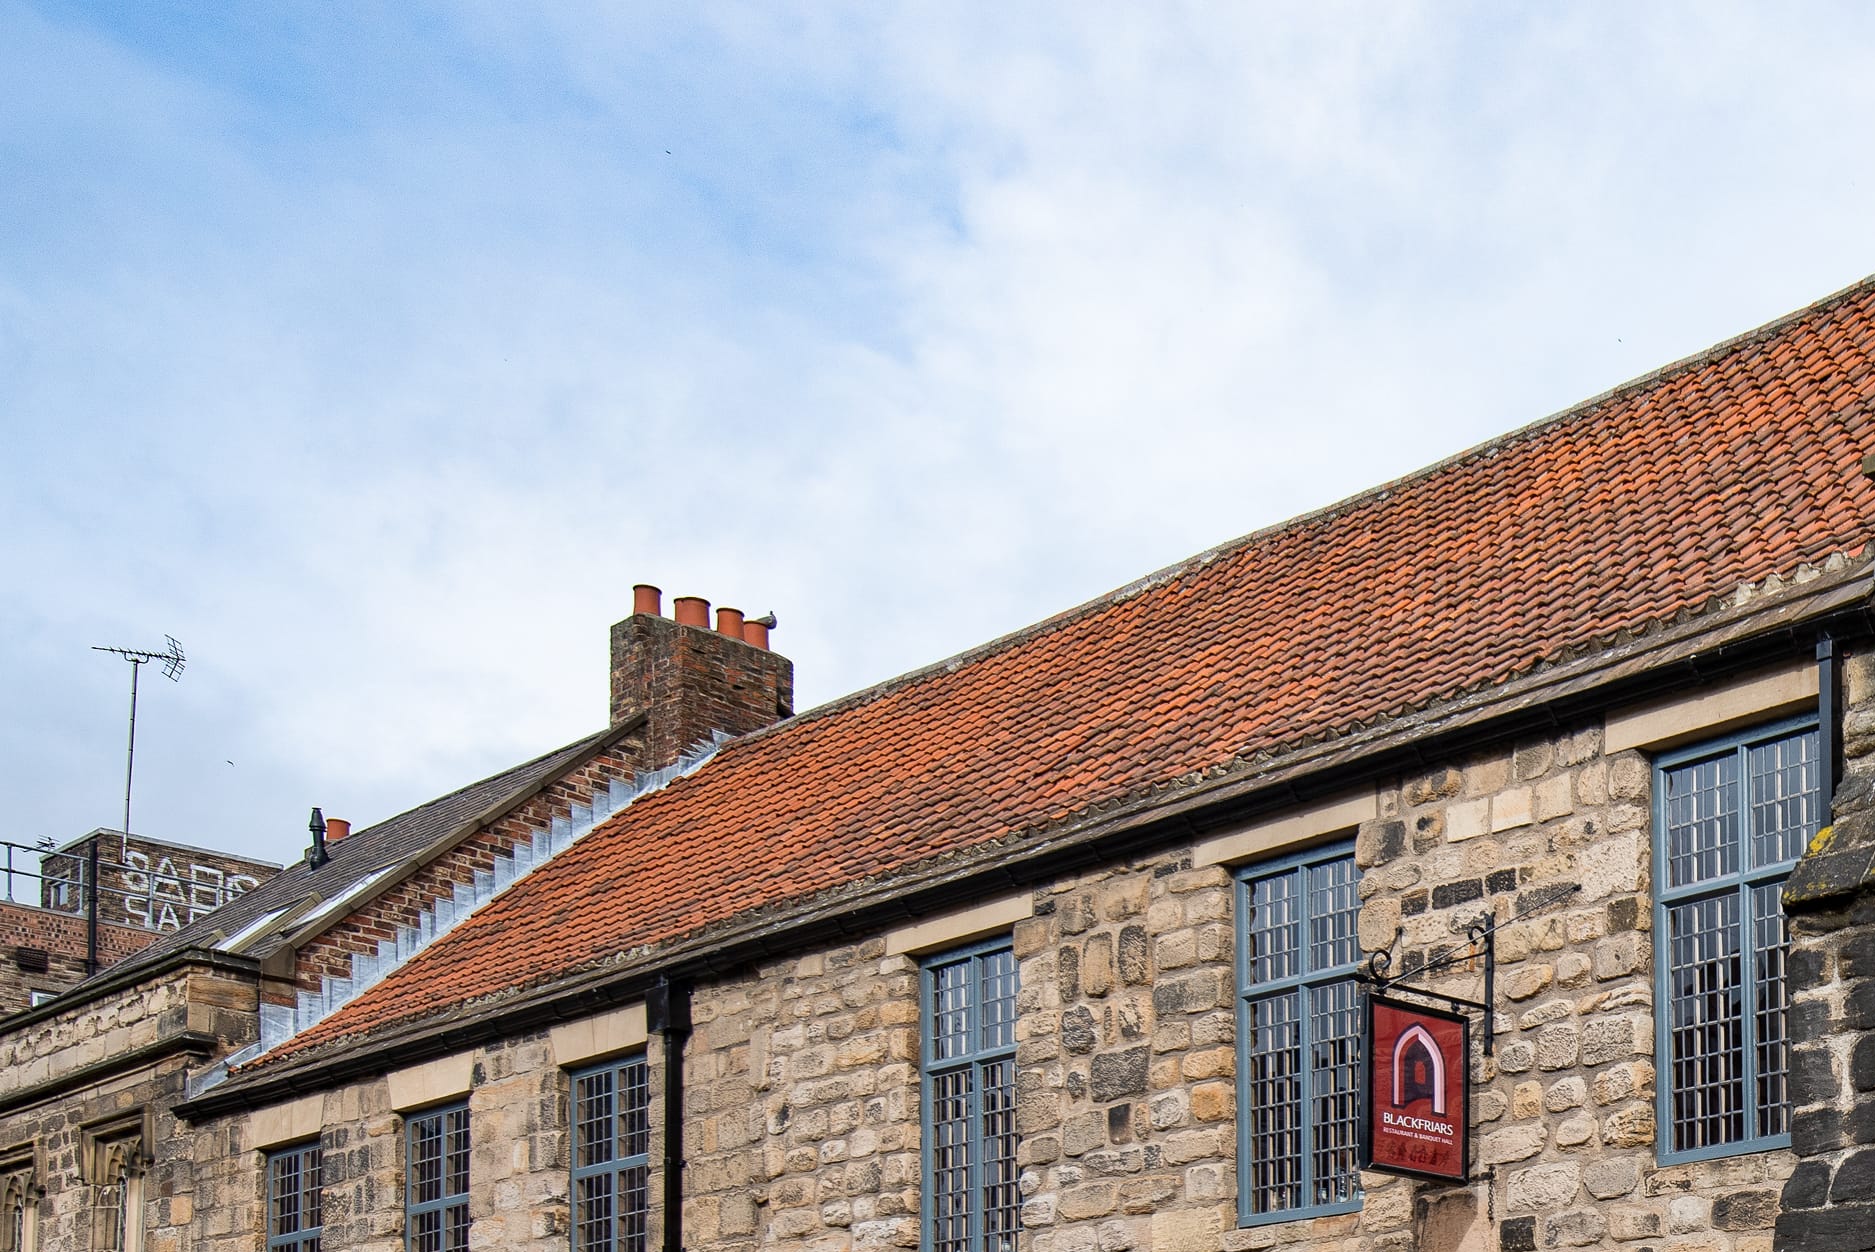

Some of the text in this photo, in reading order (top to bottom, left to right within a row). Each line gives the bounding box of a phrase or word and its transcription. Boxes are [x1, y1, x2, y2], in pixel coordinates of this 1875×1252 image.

[1383, 1112, 1453, 1136] BLACKFRIARS
[1383, 1127, 1413, 1137] RESTAURANT
[1419, 1133, 1441, 1143] BANQUET
